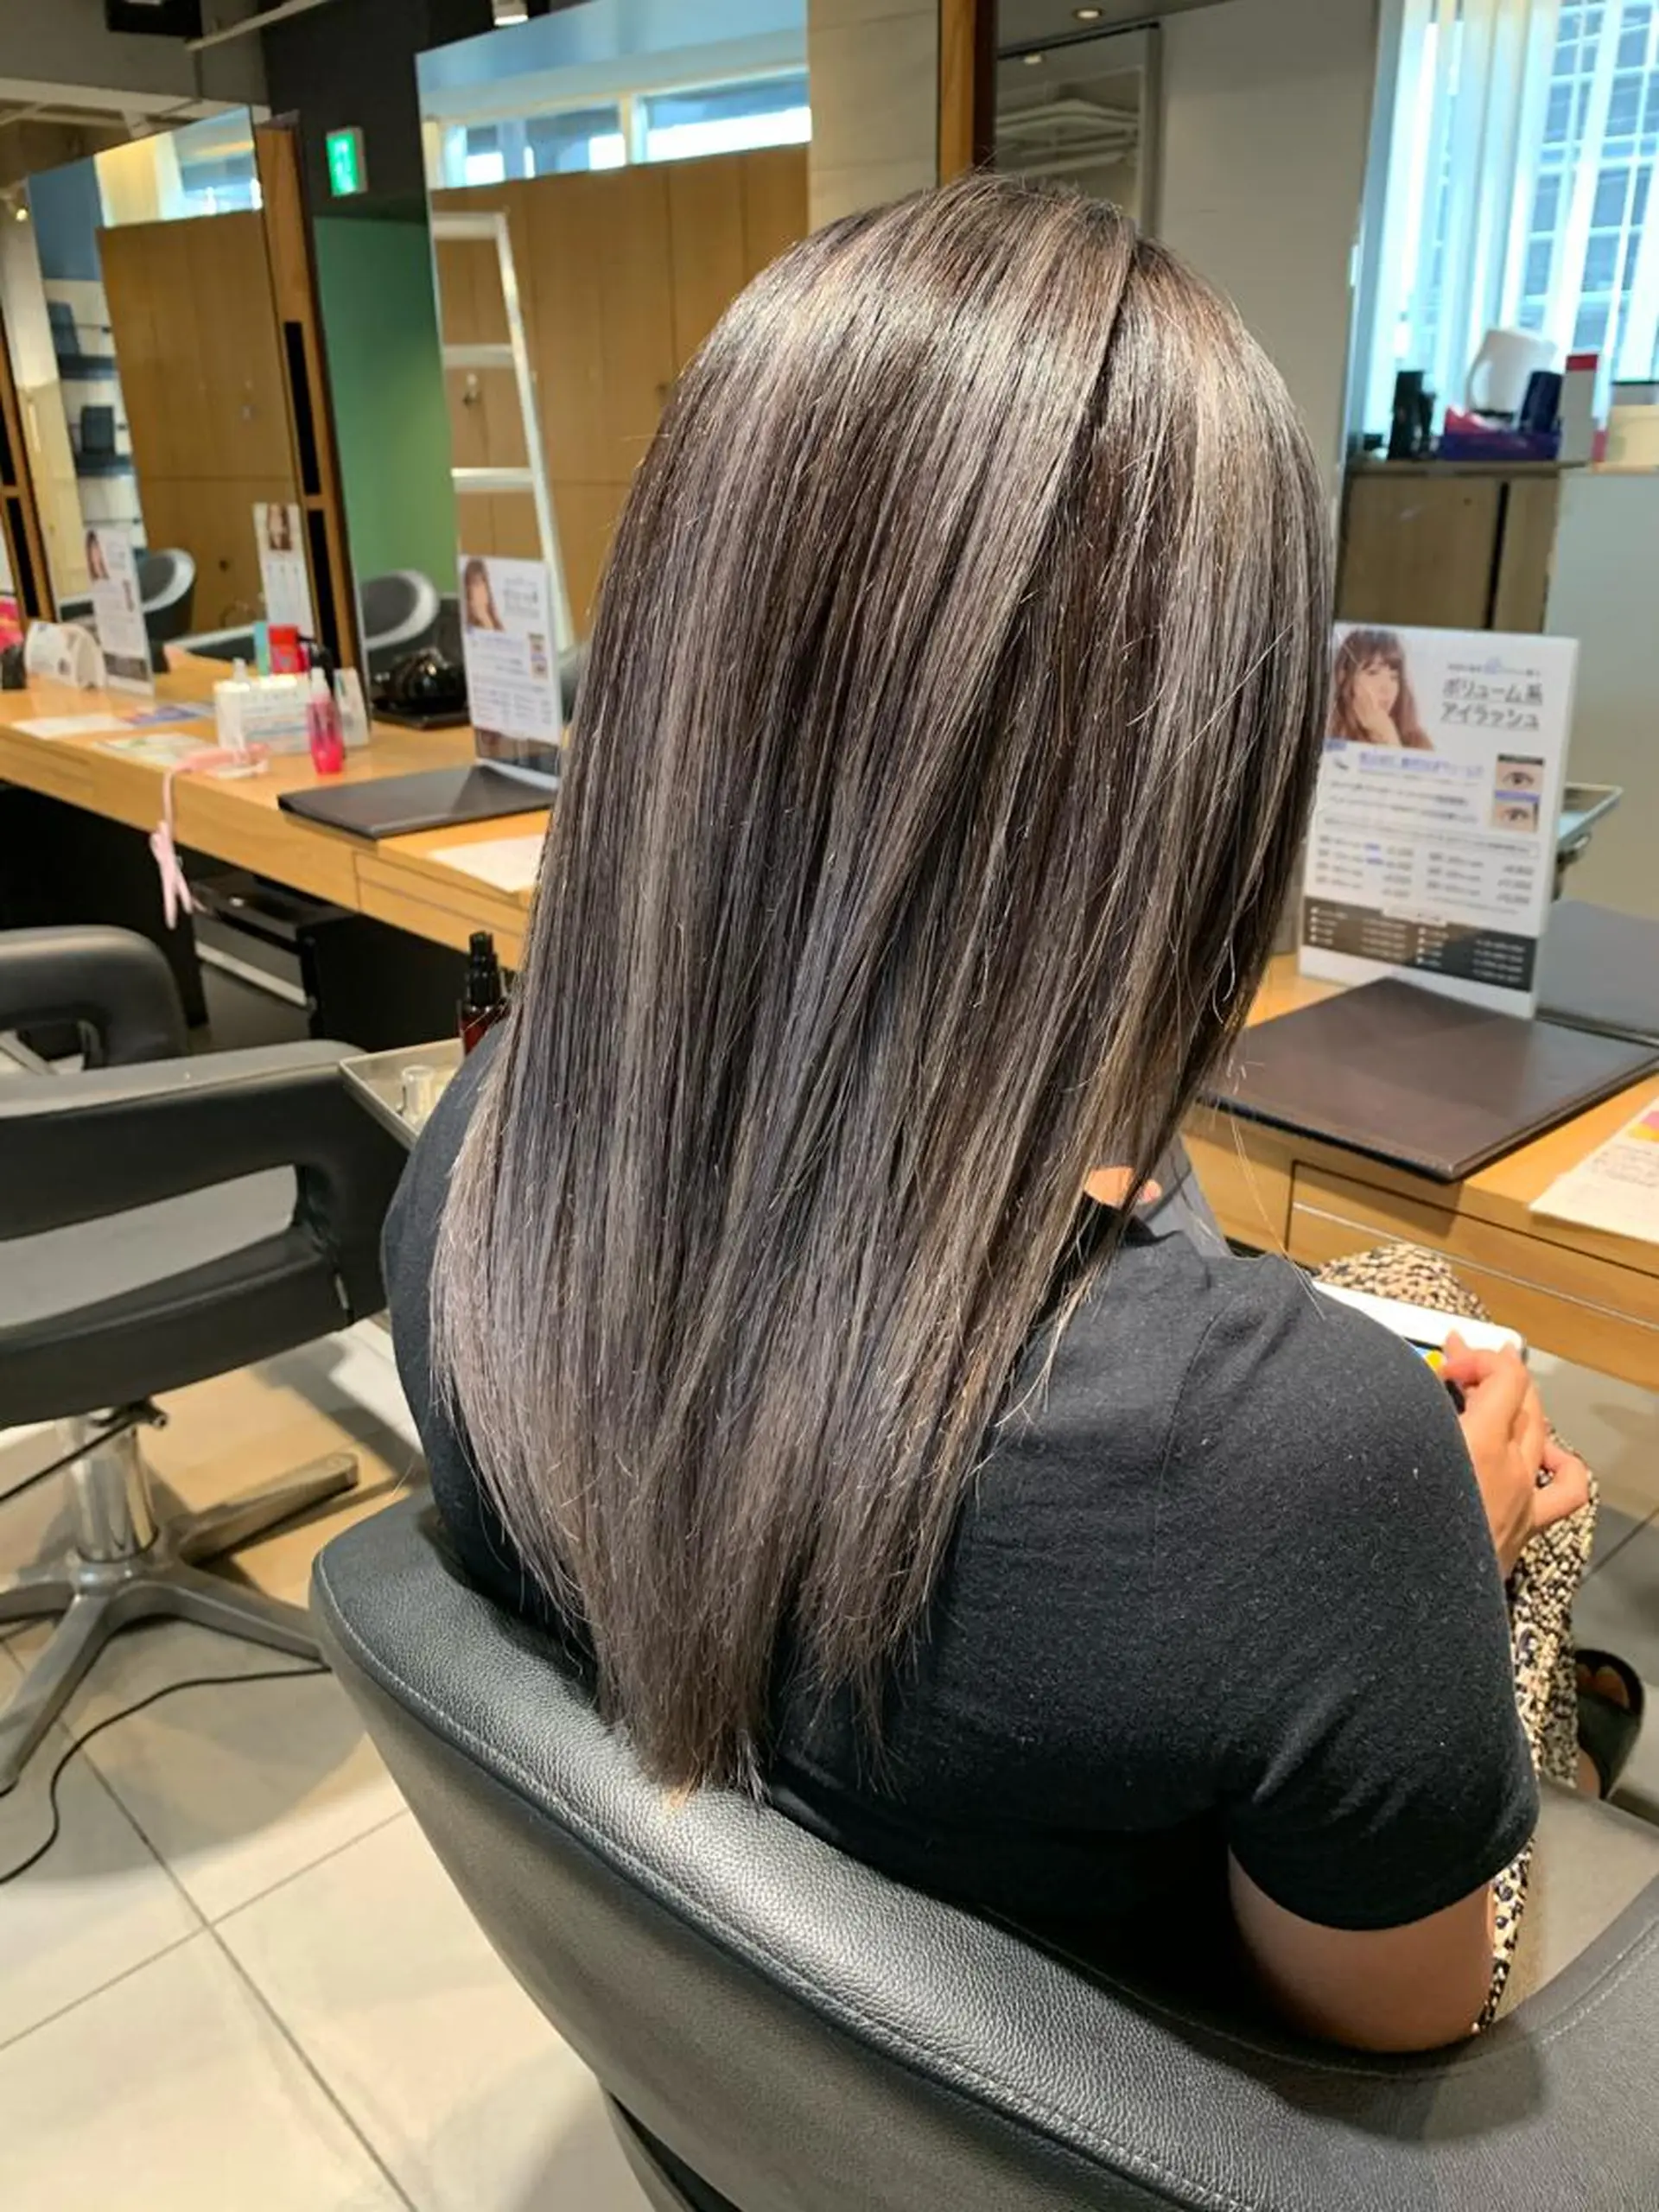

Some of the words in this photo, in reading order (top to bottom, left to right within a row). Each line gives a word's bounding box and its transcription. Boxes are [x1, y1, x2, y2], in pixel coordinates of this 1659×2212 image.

[1440, 702, 1540, 731] アイラッシュ
